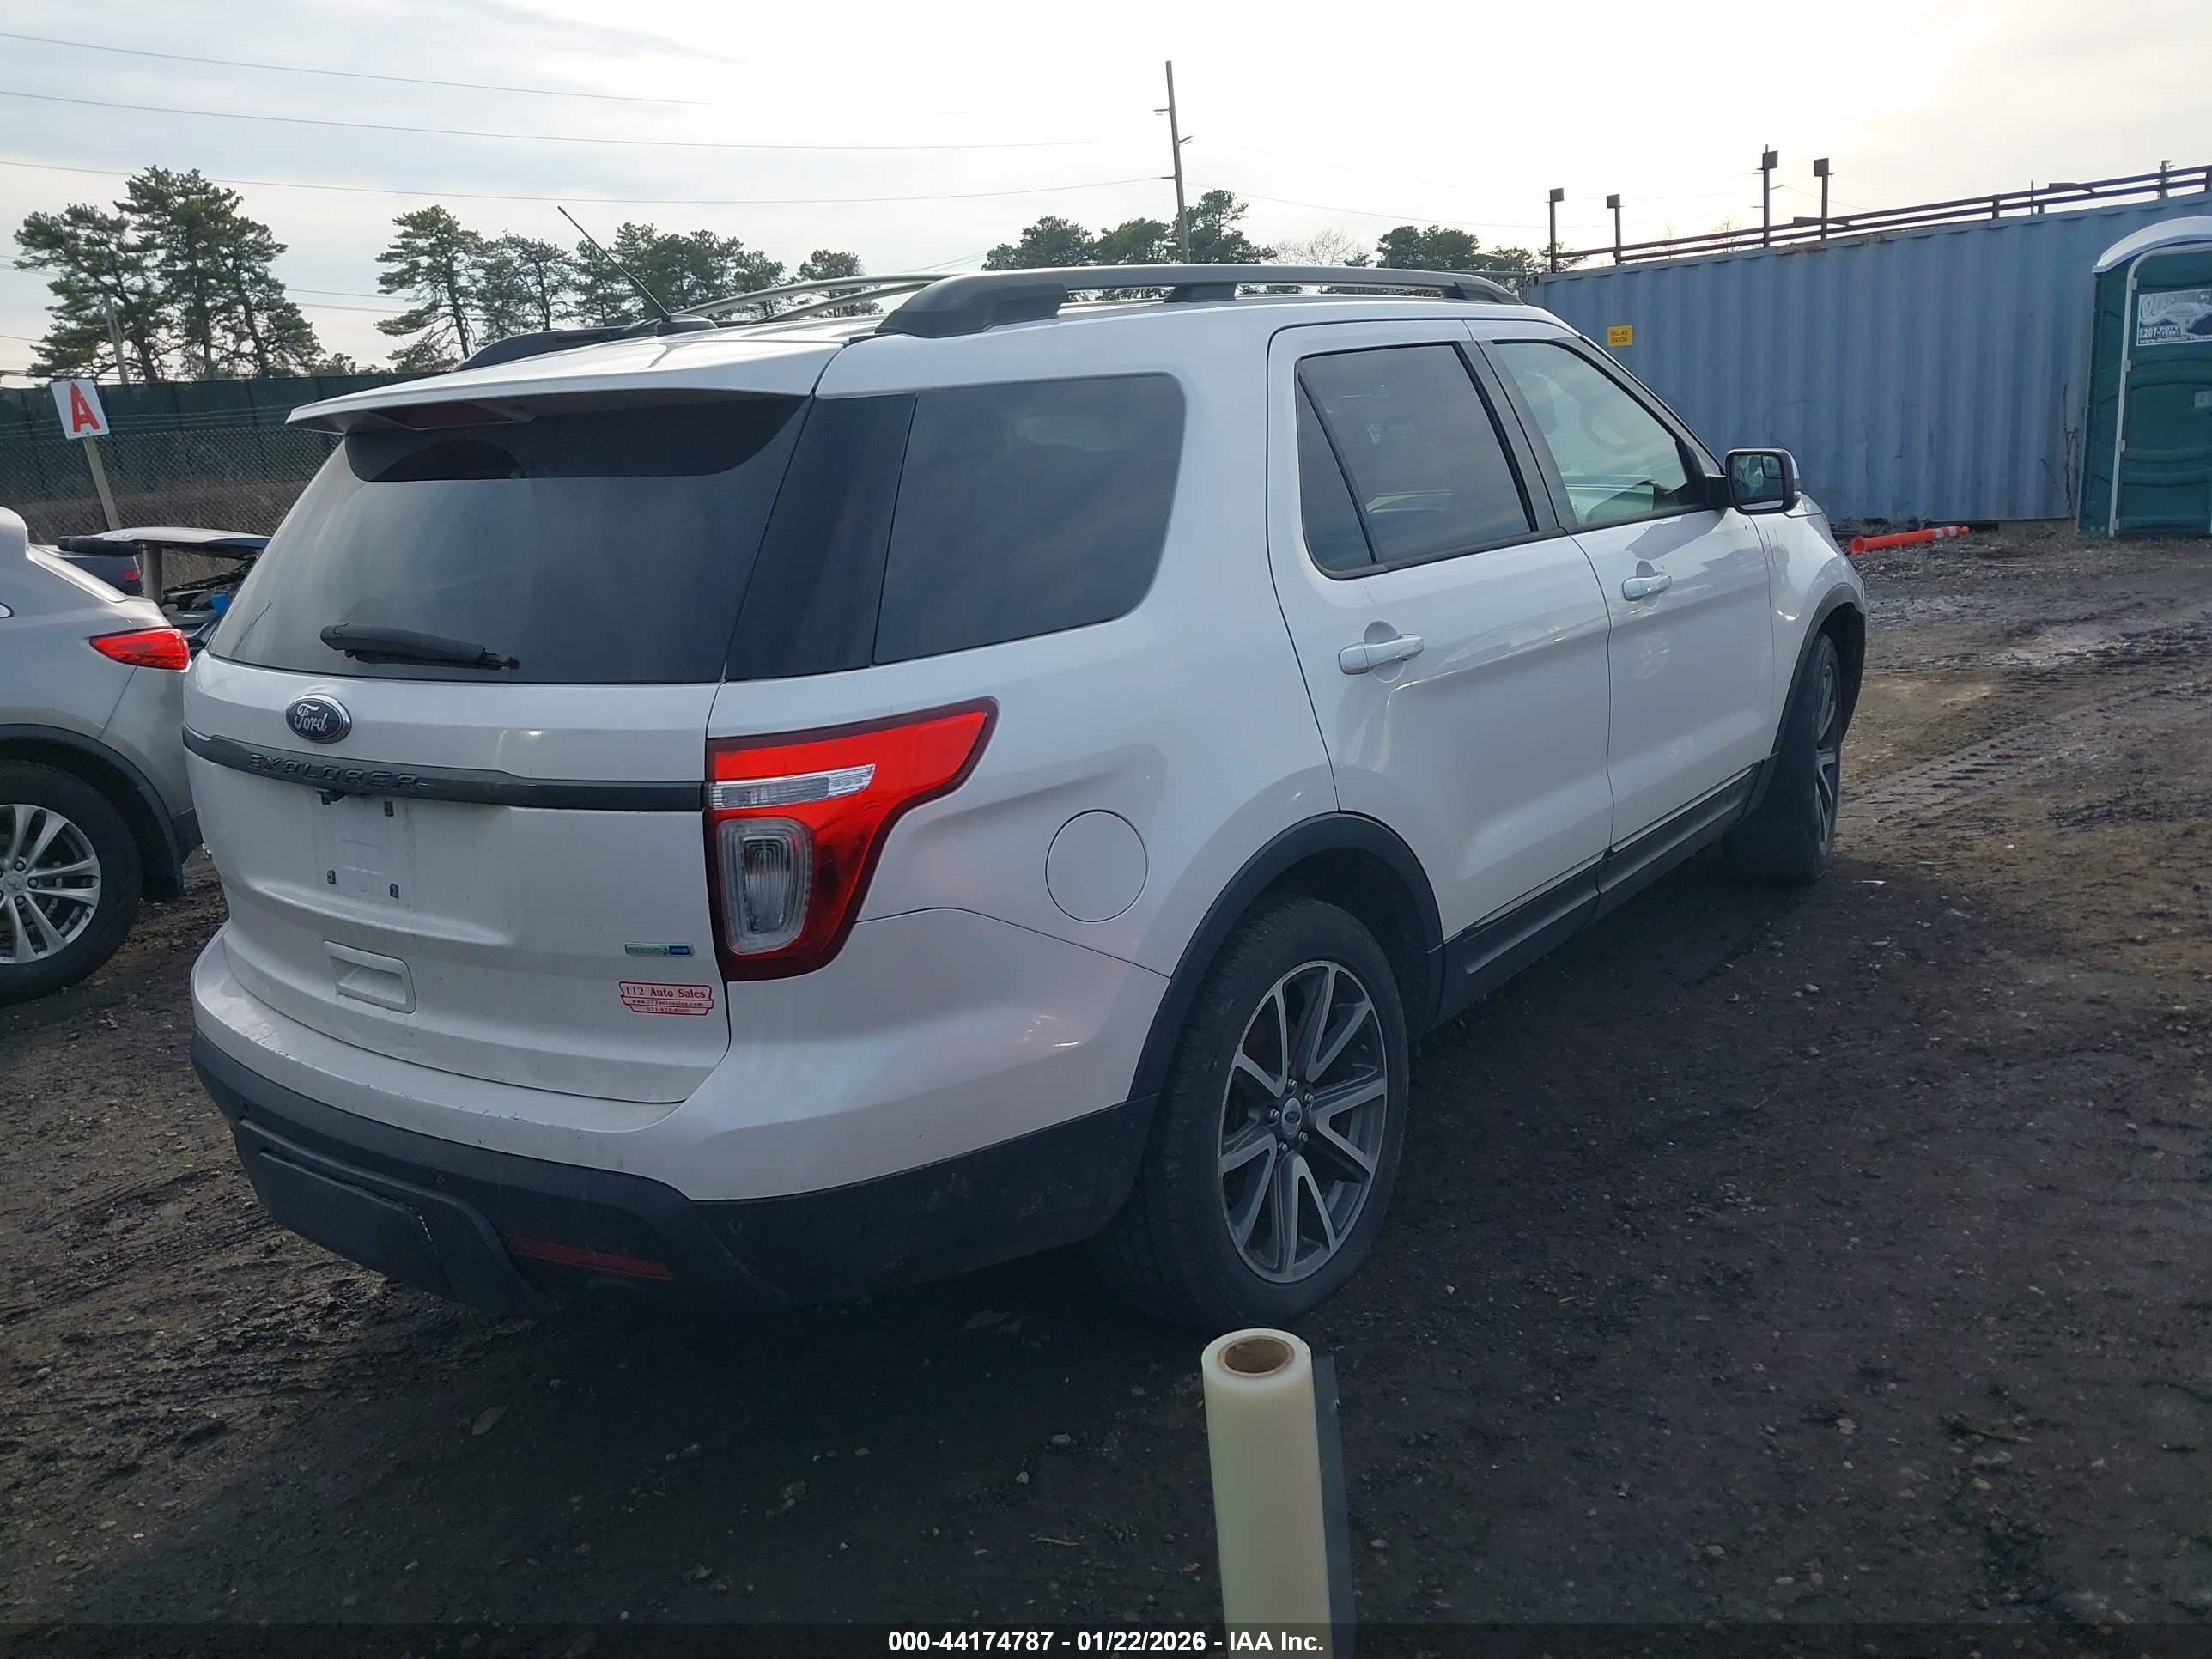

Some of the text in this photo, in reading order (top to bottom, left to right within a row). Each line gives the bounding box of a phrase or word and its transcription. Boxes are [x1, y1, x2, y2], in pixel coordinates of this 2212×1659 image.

[70, 382, 100, 433] A
[294, 702, 328, 732] Ford
[248, 753, 419, 790] EXPLORER
[625, 986, 706, 999] 112 Auto Sales
